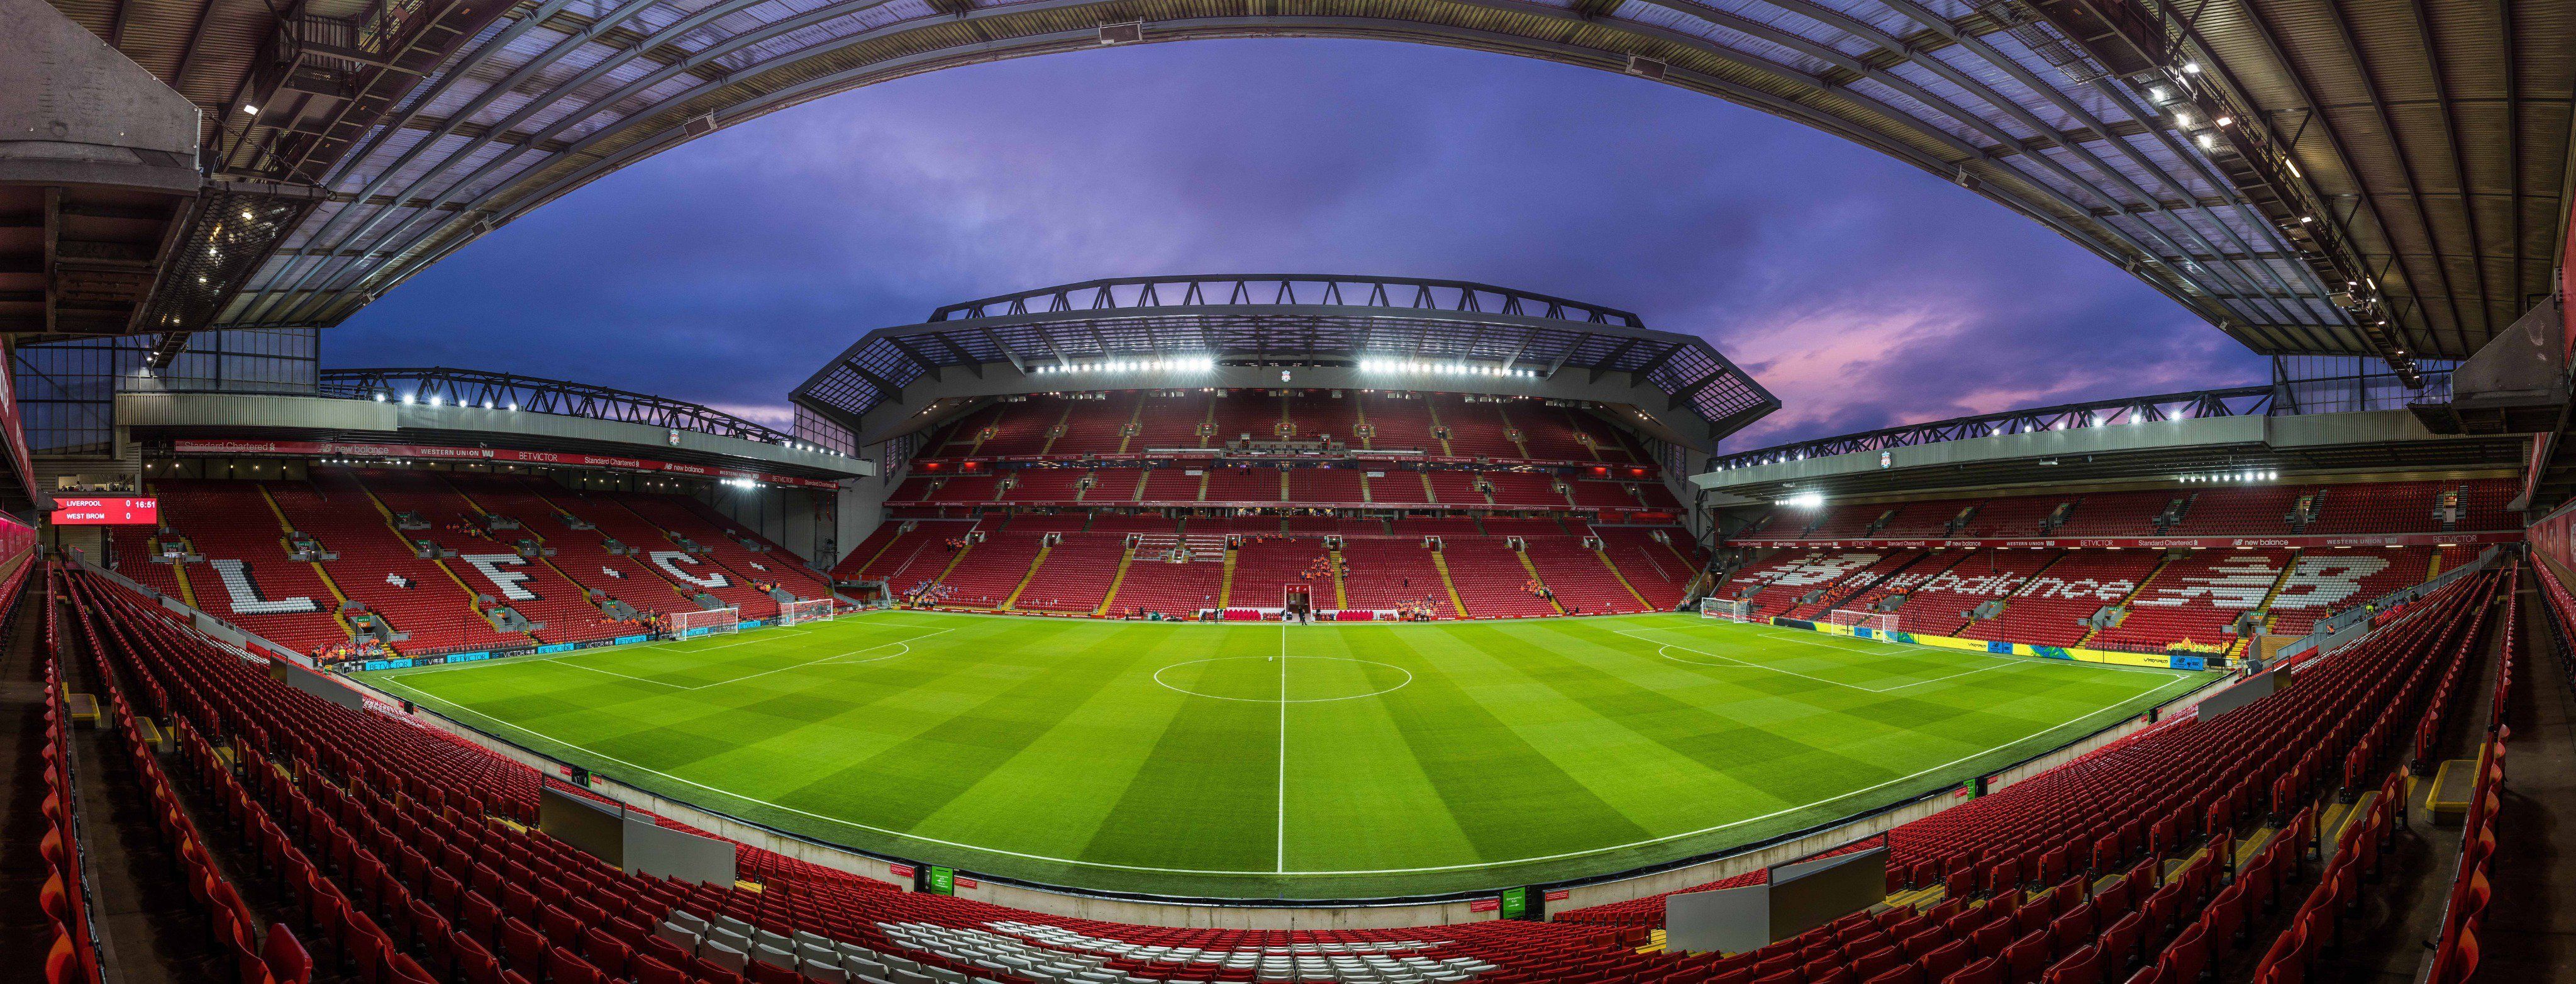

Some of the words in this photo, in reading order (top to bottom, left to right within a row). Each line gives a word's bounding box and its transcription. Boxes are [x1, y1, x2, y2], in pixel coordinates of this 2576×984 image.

[185, 442, 224, 450] Standard
[226, 442, 268, 450] Chartered
[355, 445, 389, 454] balance
[519, 452, 558, 461] BETVICTOR
[585, 457, 609, 465] Standard
[610, 458, 635, 466] Chartered
[210, 559, 316, 613] L
[460, 554, 536, 601] F
